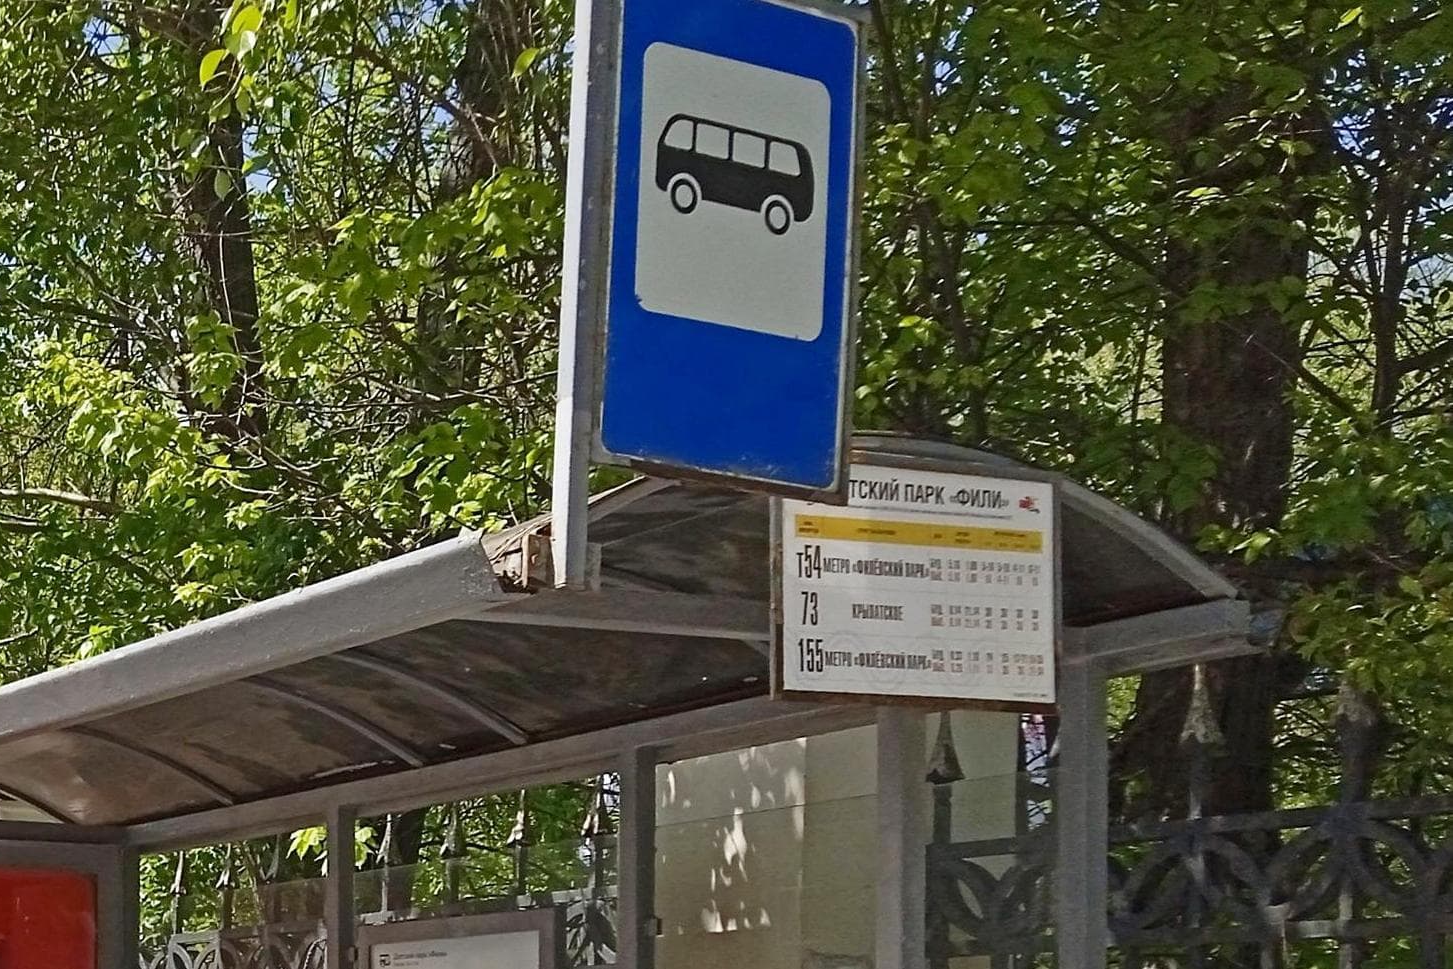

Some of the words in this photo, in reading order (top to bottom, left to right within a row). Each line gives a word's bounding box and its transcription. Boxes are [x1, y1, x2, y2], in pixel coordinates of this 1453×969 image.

[849, 478, 899, 502] ТСКИЙ
[904, 484, 945, 505] ПАРК
[950, 488, 1010, 509] «ФИЛИ»
[823, 557, 851, 574] МЕТРО
[801, 591, 818, 626] 73
[852, 603, 904, 621] КРЫЛАТСКОЕ
[797, 638, 824, 673] 155
[825, 651, 852, 667] МЕТРО
